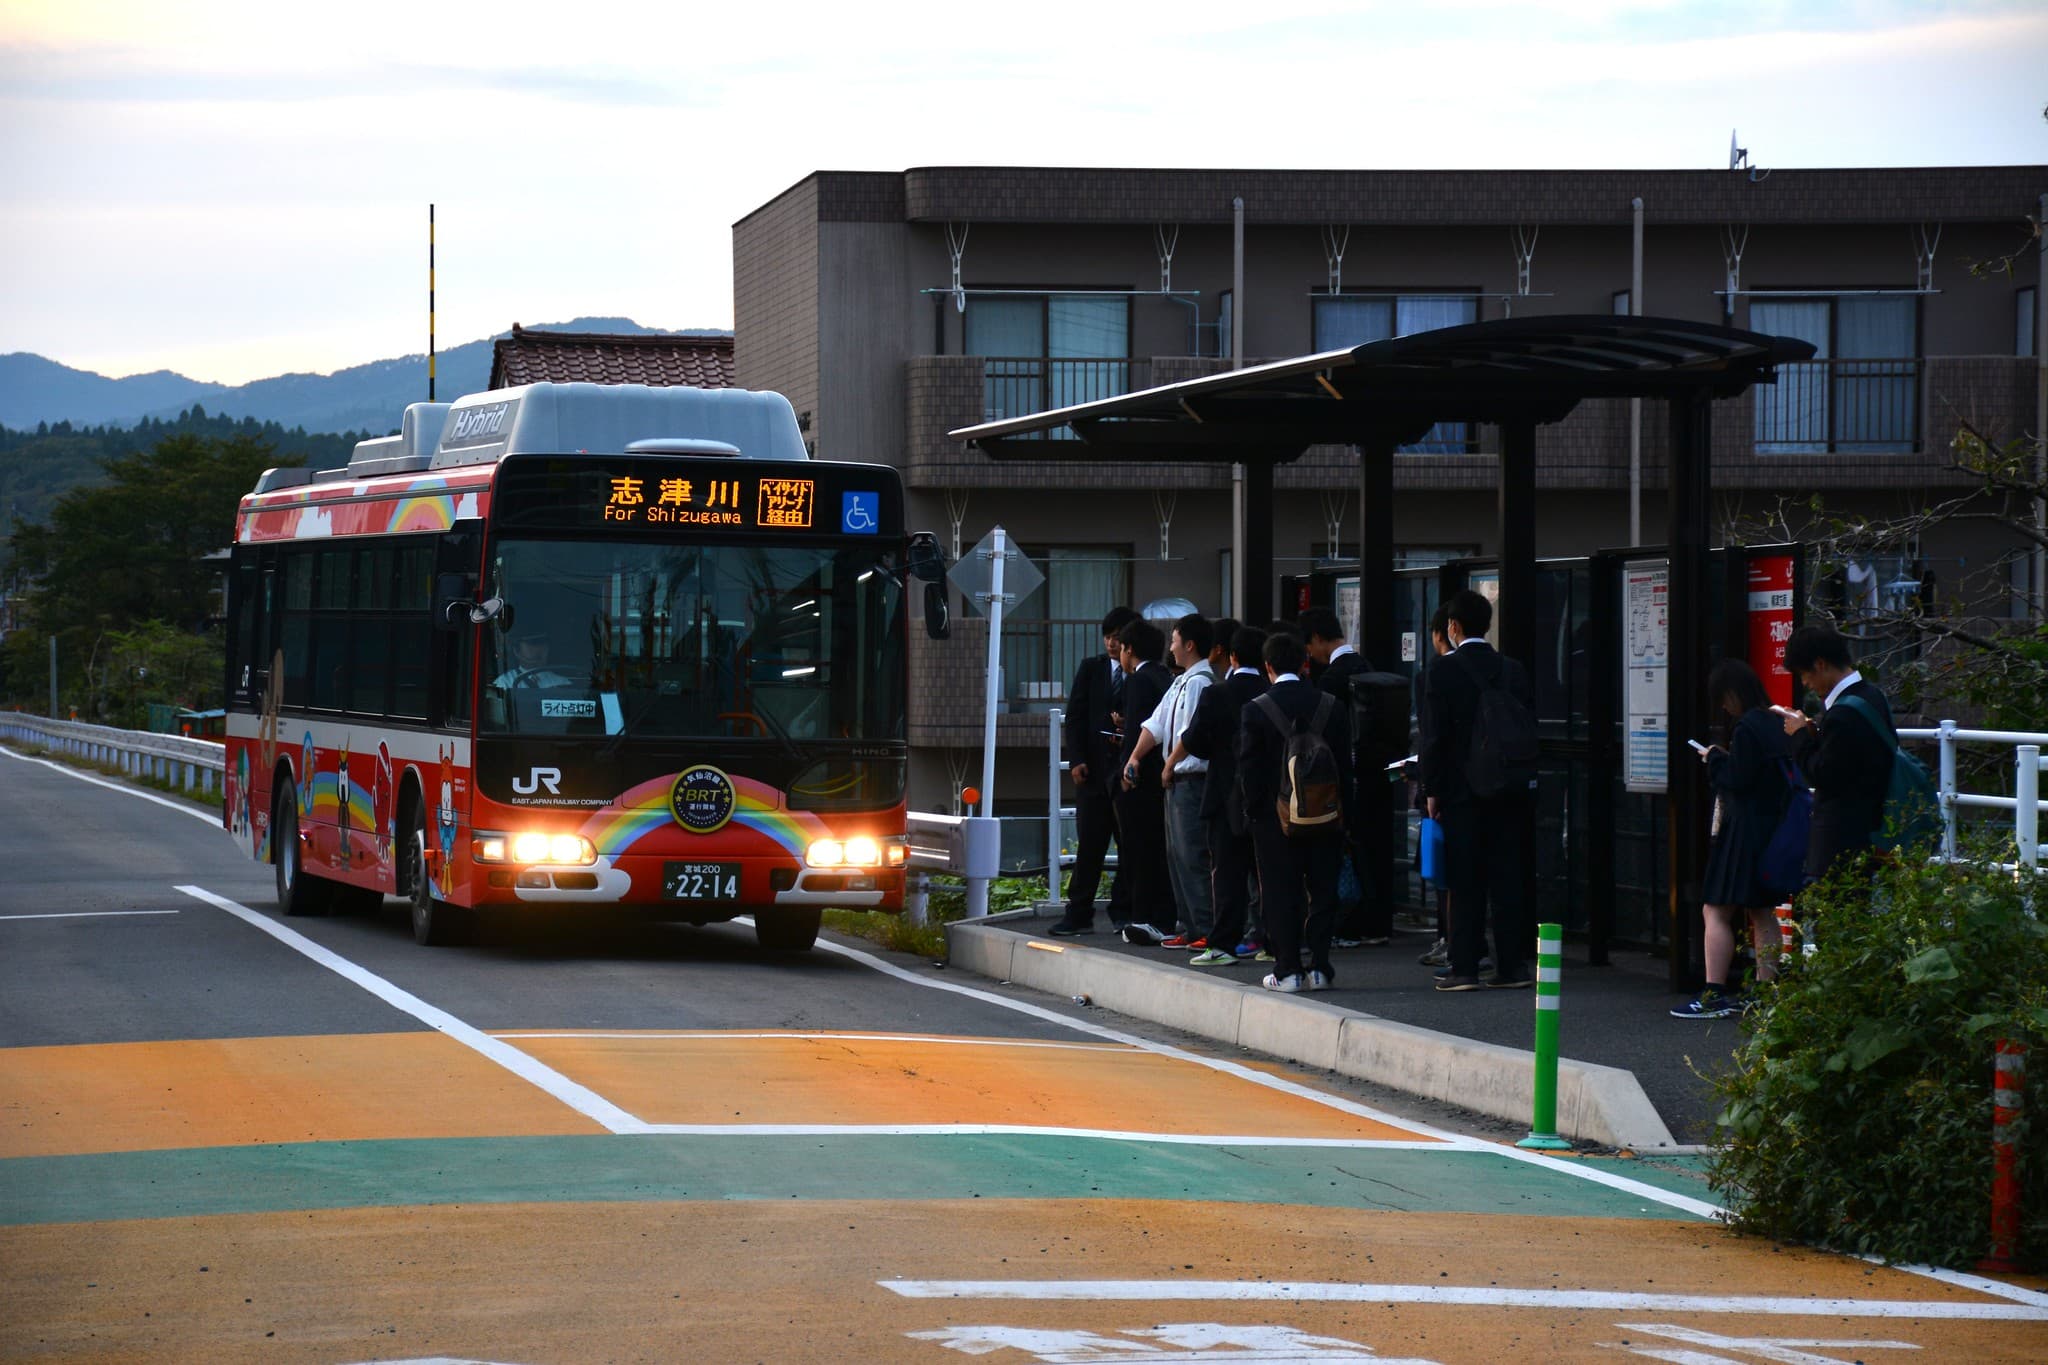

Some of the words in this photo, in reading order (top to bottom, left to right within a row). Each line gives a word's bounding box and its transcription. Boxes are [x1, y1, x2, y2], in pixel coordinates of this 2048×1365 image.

[450, 403, 509, 439] Hybrid
[609, 476, 740, 508] 志津川
[762, 481, 811, 493] ベイサイド
[767, 495, 805, 509] アリーナ
[604, 505, 636, 521] For
[647, 507, 742, 524] Shizugawa
[766, 510, 803, 524] 経由
[543, 702, 594, 715] ライト点灯中
[851, 747, 889, 756] HINO
[512, 767, 562, 795] JR
[685, 789, 721, 802] BRT
